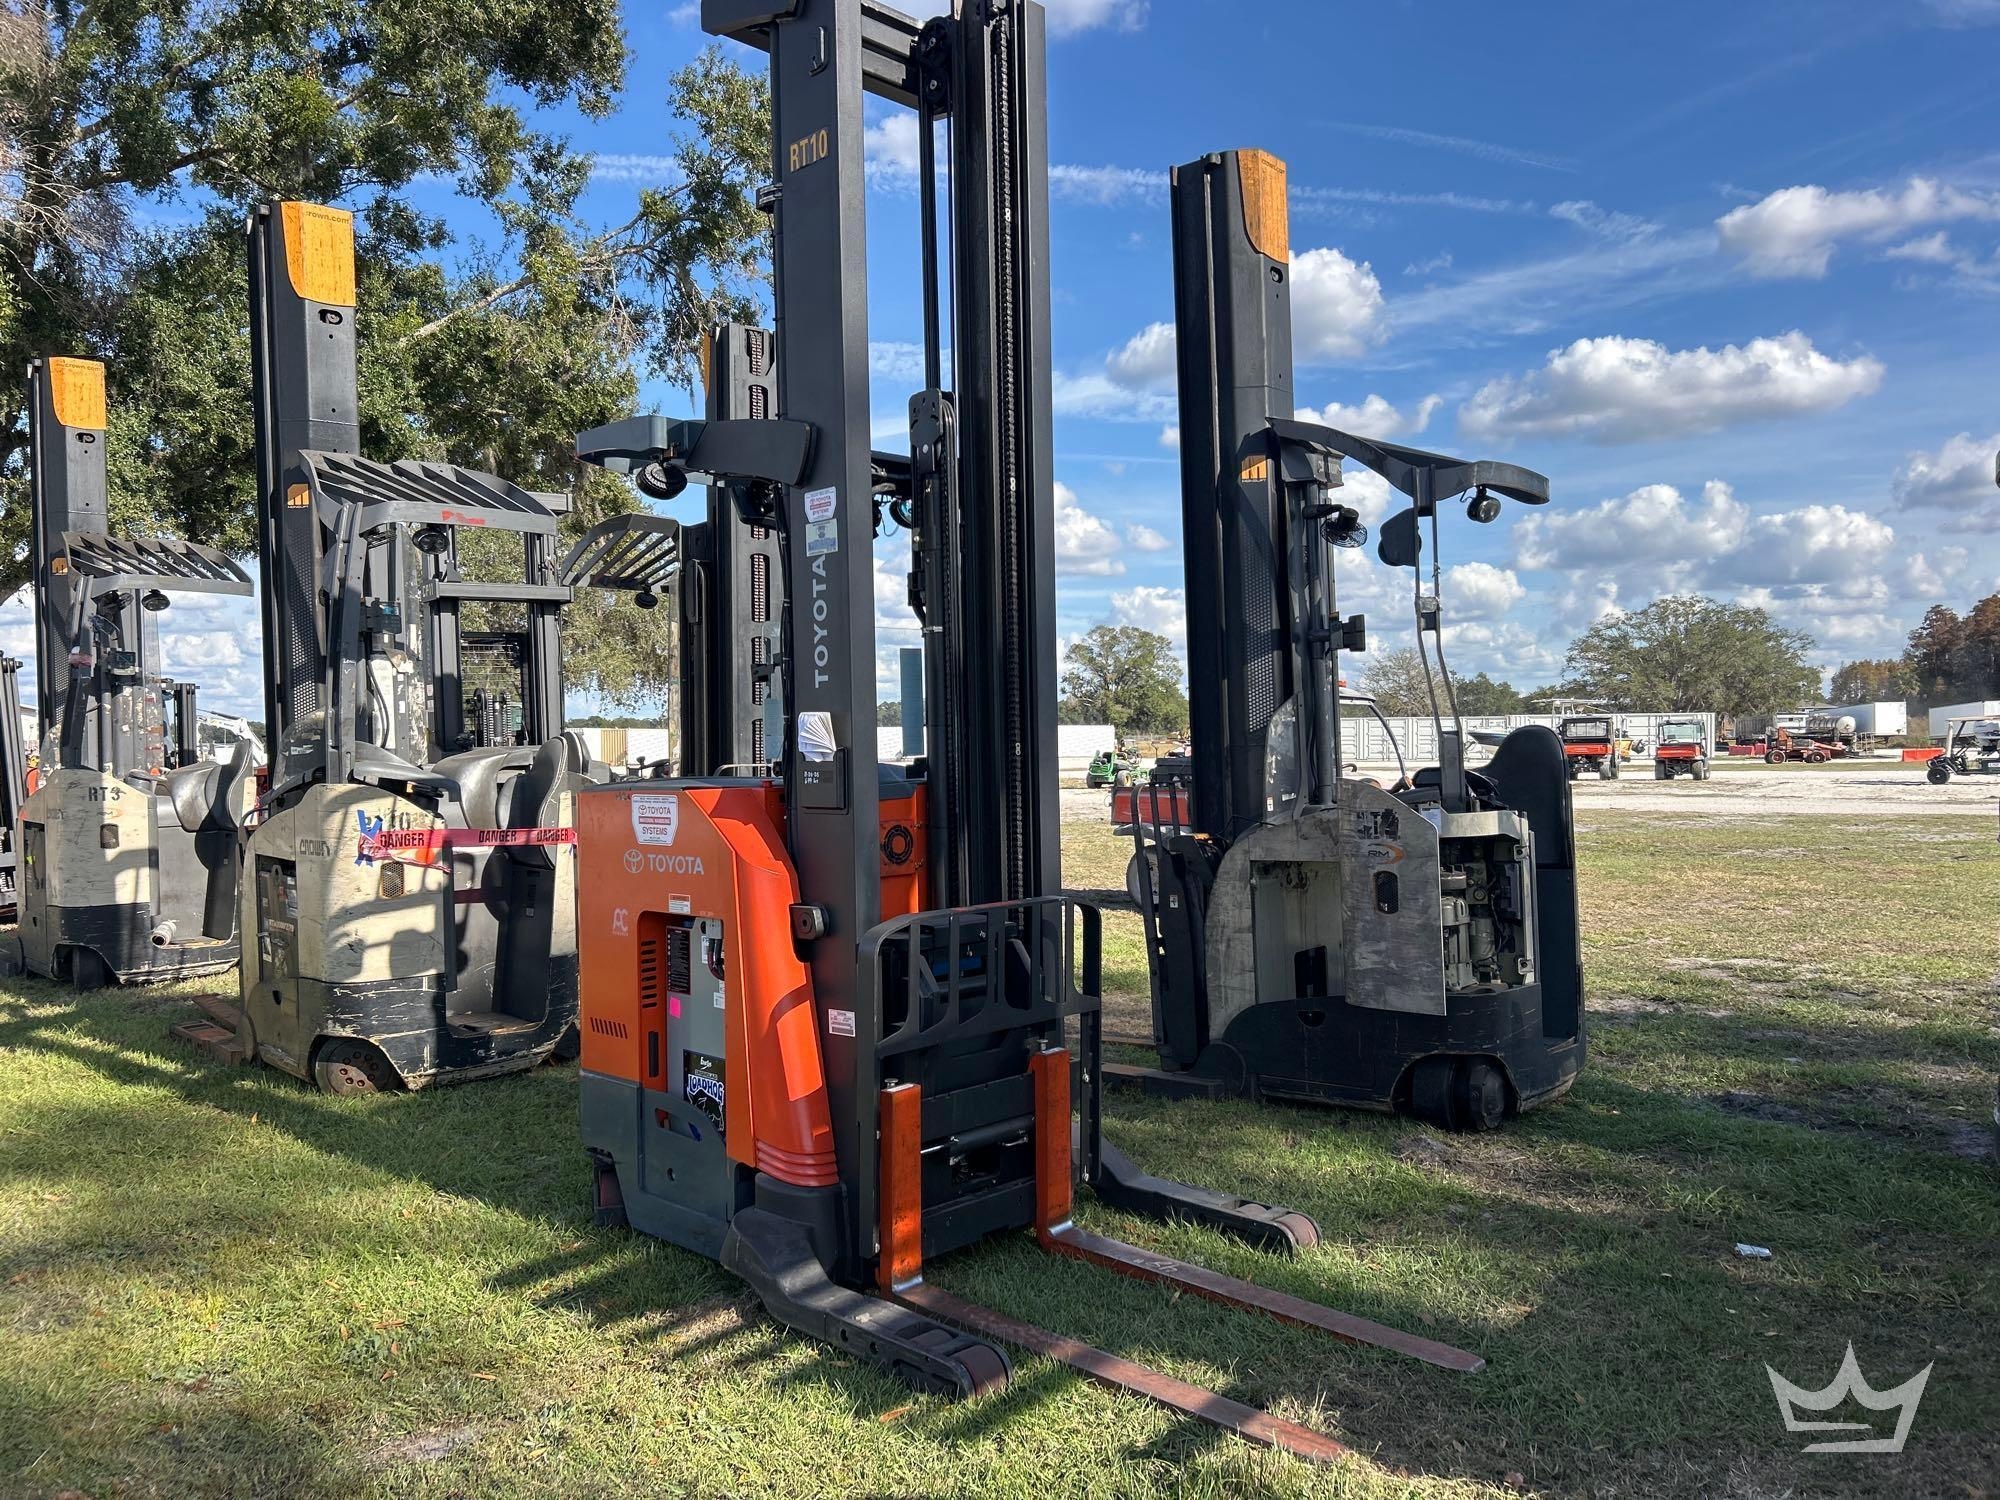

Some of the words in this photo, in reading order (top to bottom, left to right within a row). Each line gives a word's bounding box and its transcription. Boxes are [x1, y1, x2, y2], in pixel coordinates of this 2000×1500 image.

[812, 554, 829, 688] TOYOTA
[647, 806, 671, 815] TOYOTA
[479, 830, 516, 842] DANGER
[537, 829, 568, 841] DANGER
[642, 827, 667, 835] SYSTEMS
[380, 833, 425, 847] DANGER
[648, 854, 704, 875] TOYOTA
[688, 1074, 724, 1105] LOADHOG
